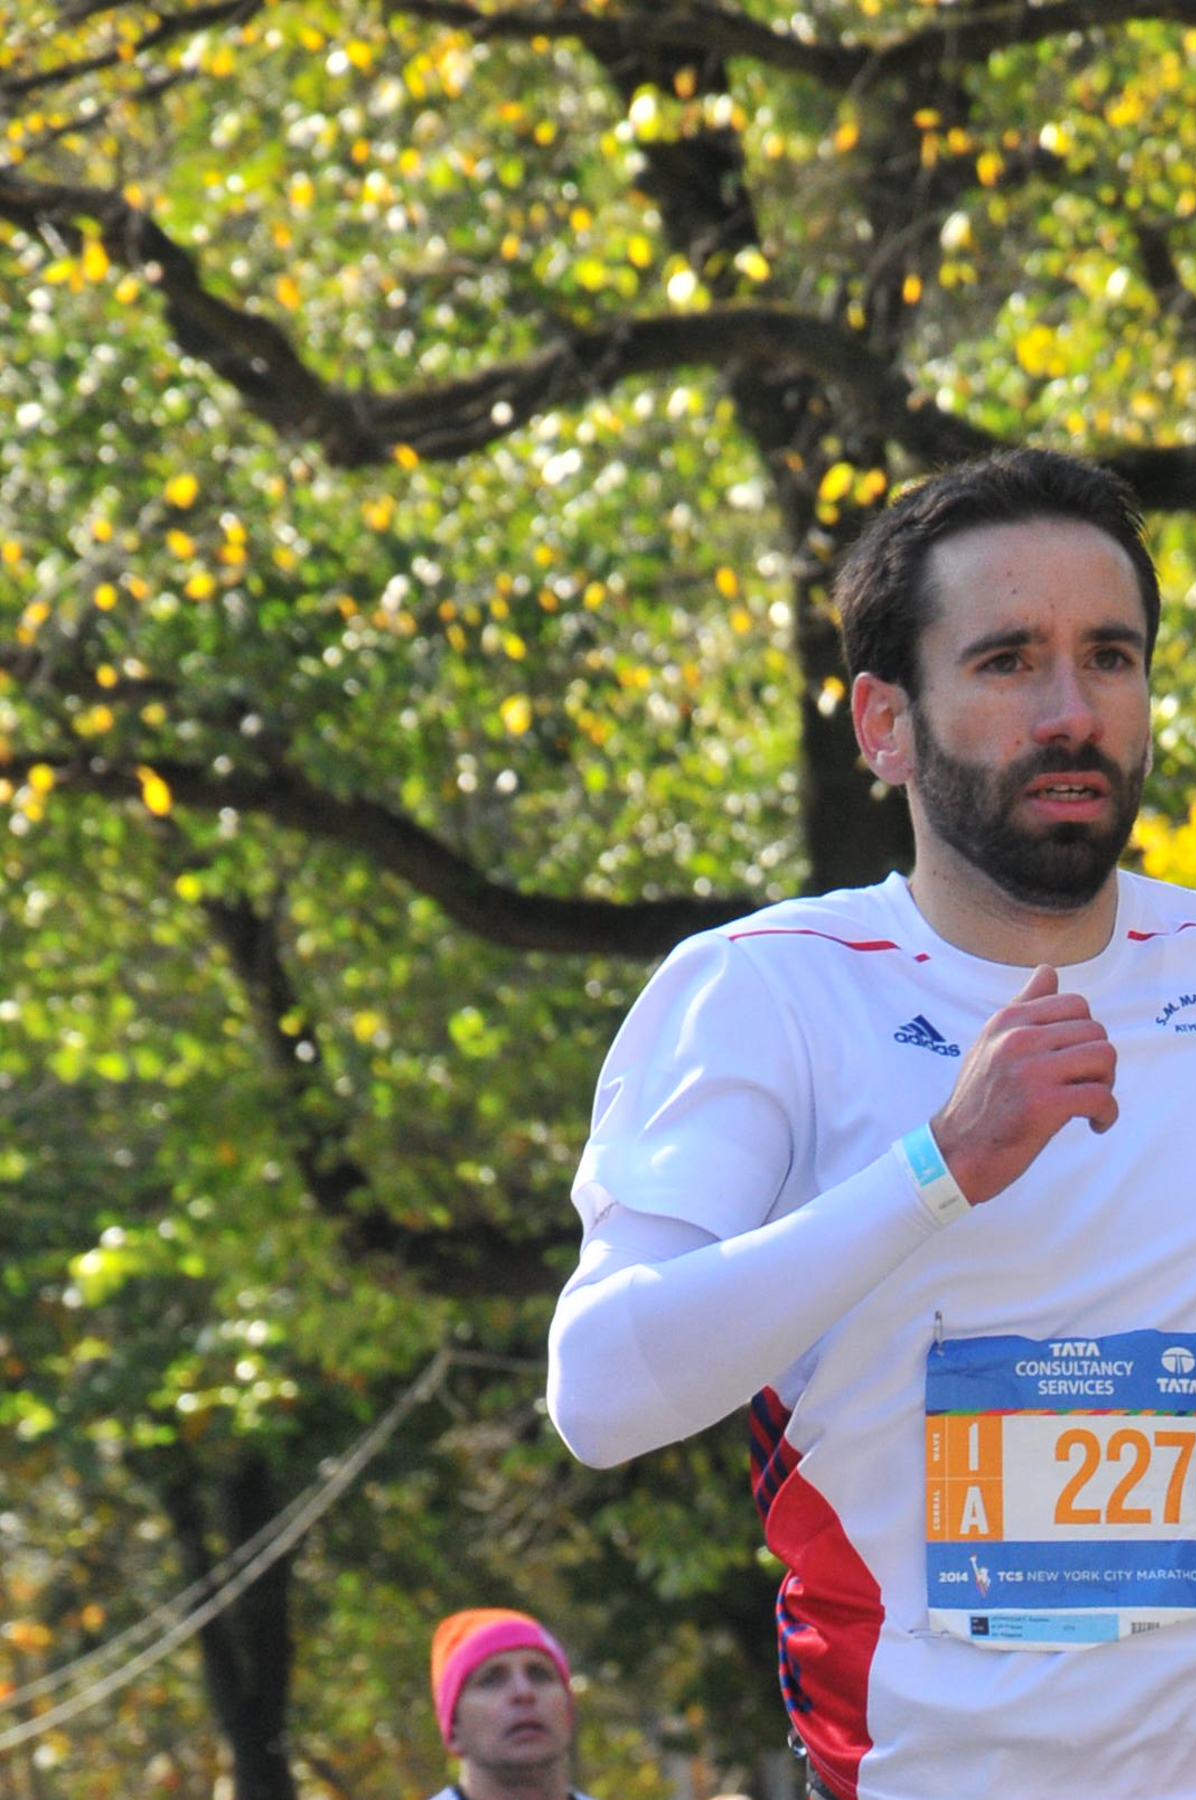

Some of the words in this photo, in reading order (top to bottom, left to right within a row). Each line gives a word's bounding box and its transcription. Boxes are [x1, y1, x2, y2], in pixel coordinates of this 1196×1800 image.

[894, 1031, 961, 1057] adidas
[1049, 1342, 1100, 1357] TATA
[1015, 1361, 1134, 1376] CONSULTANCY
[1038, 1379, 1115, 1395] SERVICES
[959, 1485, 989, 1535] A
[939, 1572, 969, 1583] 2014
[998, 1572, 1024, 1582] TCS
[1027, 1572, 1058, 1581] NEW
[1064, 1571, 1100, 1581] YORK
[1104, 1571, 1132, 1581] CITY
